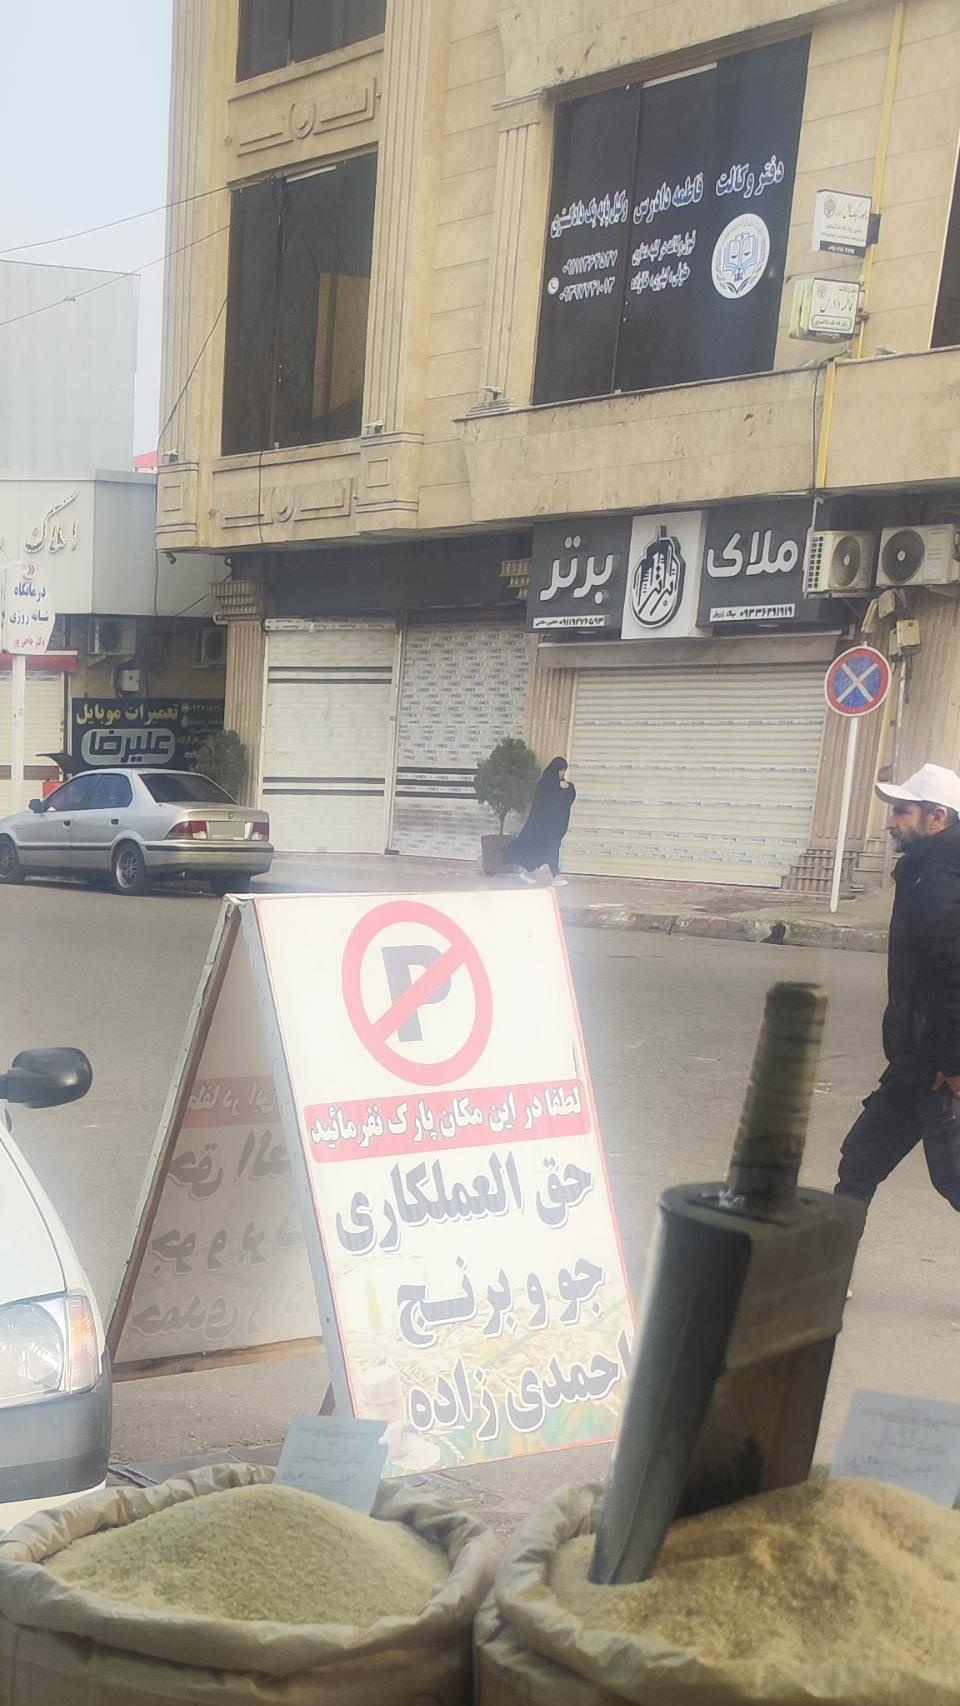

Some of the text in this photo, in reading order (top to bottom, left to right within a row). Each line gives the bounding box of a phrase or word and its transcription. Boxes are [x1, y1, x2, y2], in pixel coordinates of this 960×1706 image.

[672, 172, 703, 207] فاطمه
[716, 155, 784, 198] دفتر وکالت
[13, 576, 46, 602] درمانگاه
[540, 535, 614, 604] برتر
[9, 612, 30, 625] روزی
[76, 703, 121, 725] موبایل
[125, 703, 178, 725] تعمیرات
[89, 730, 171, 763] علیرضا
[440, 1096, 483, 1138] مکان
[489, 1092, 516, 1131] این
[524, 1095, 541, 1129] در
[544, 1086, 582, 1117] لطفا
[310, 1104, 384, 1148] نفرمائید
[335, 1151, 524, 1255] العملکاری
[535, 1157, 593, 1229] حق
[396, 1256, 604, 1349] جو و برنج
[408, 1329, 634, 1442] احمدی زاده
